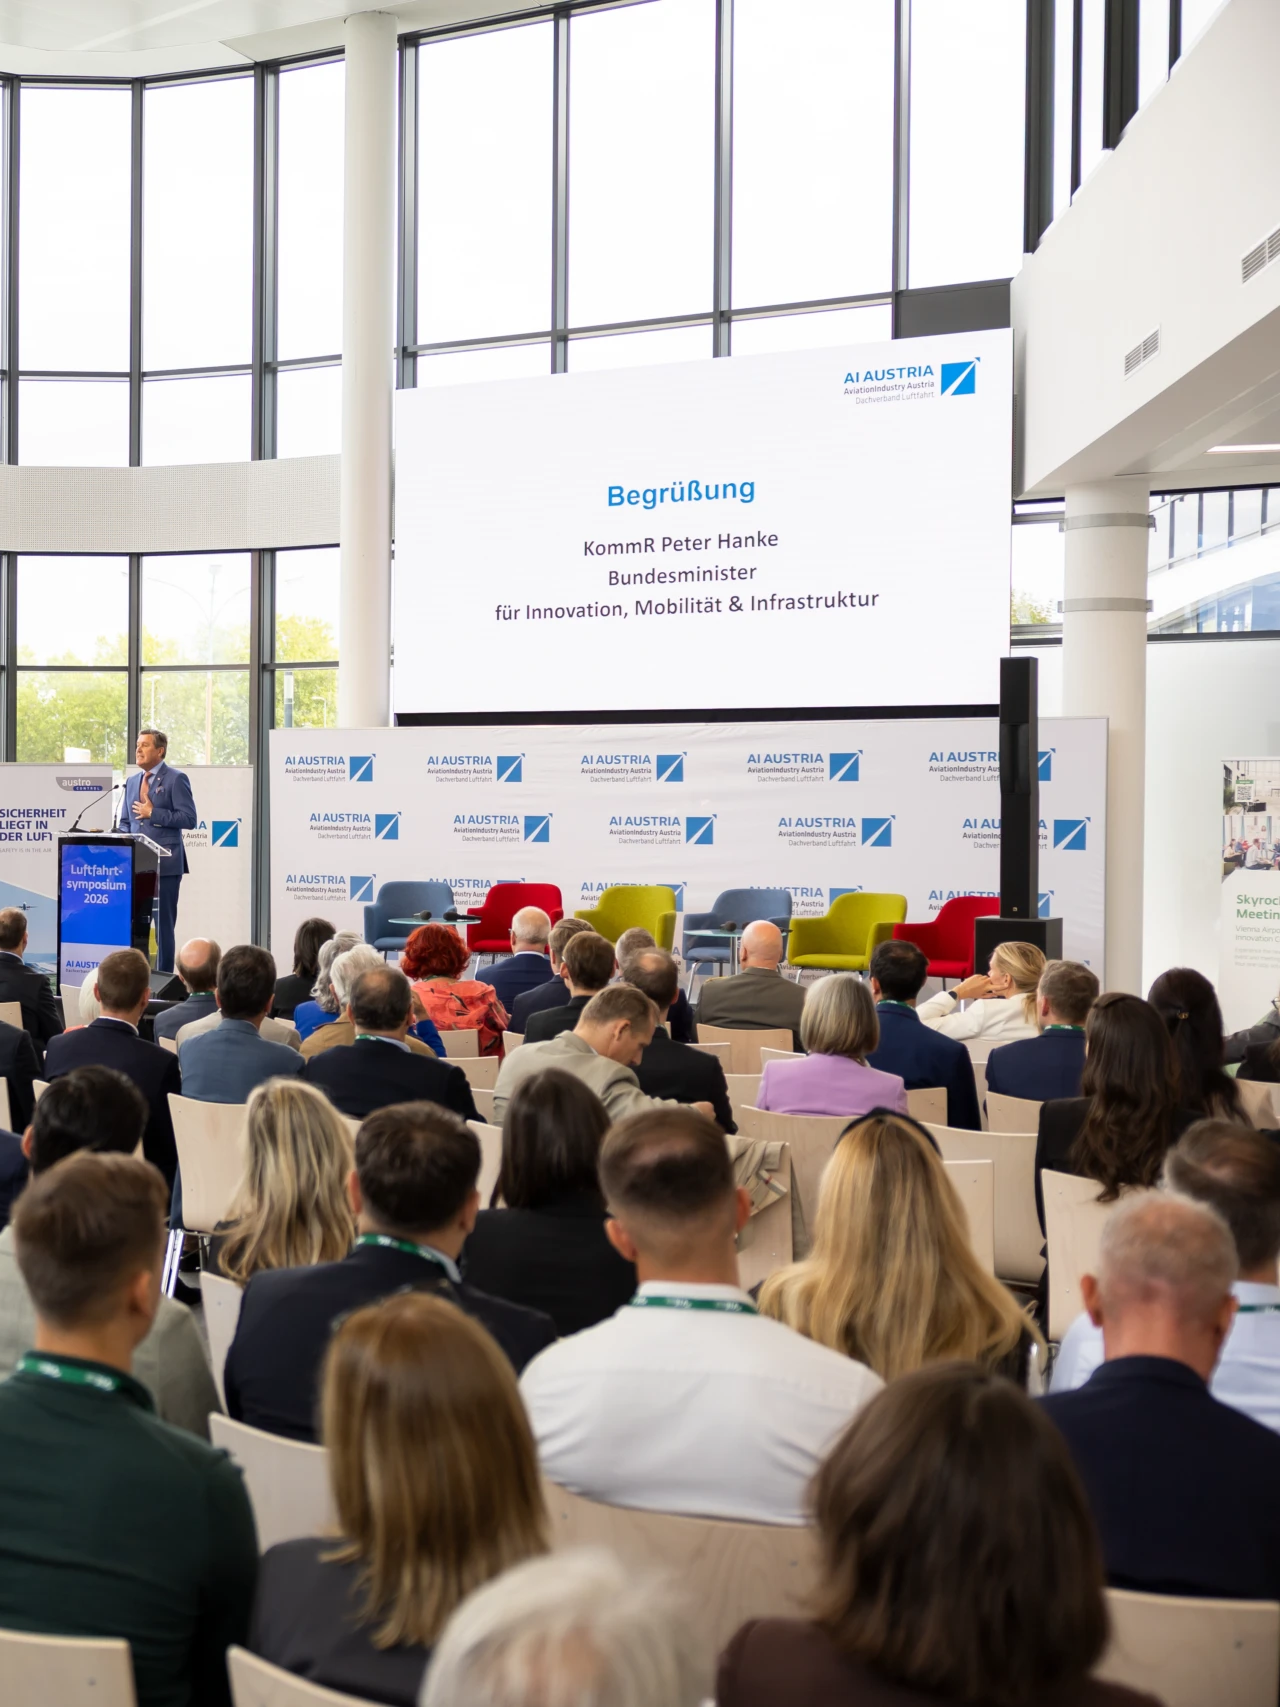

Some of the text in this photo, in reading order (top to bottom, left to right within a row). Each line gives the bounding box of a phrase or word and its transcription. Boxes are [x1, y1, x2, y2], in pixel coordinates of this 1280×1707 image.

[844, 365, 934, 384] AI AUSTRIA
[844, 380, 934, 395] AviationIndustry Austria
[856, 391, 934, 405] Dachverband Luftfahrt
[608, 479, 755, 510] Begrüßung
[584, 531, 779, 556] KommR Peter Hanke
[608, 565, 757, 586] Bundesminister
[495, 590, 879, 621] für Innovation, Mobilität & Infrastruktur
[285, 756, 345, 765] AI AUSTRIA
[427, 756, 492, 765] AI AUSTRIA
[581, 755, 651, 764] AI AUSTRIA
[747, 753, 824, 764] AI AUSTRIA
[929, 752, 1000, 762] AI AUSTR
[581, 767, 629, 775] AviationIndustry
[747, 766, 800, 774] AviationIndustry
[929, 765, 986, 773] AviationIndustry
[62, 778, 91, 786] austro
[940, 774, 981, 782] Dachverband
[0, 808, 67, 818] SICHERHEIT
[310, 813, 370, 822] AI AUSTRIA
[0, 820, 48, 830] LIEGT IN
[453, 815, 519, 825] AI AUSTRIA
[609, 816, 681, 826] AI AUSTRIA
[778, 818, 856, 828] AI AUSTRIA
[963, 818, 978, 829] AI
[310, 824, 352, 832] AviationIndustry
[453, 827, 498, 835] AviationIndustry
[609, 828, 658, 836] AviationIndustry
[0, 832, 23, 841] DER
[496, 835, 520, 843] Luftfahrt
[778, 830, 832, 839] AviationIndustry
[655, 837, 681, 845] Luftfahrt
[828, 839, 856, 847] Luftfahrt
[71, 864, 123, 876] Luftfahrt-
[286, 874, 346, 884] AI AUSTRIA
[67, 879, 127, 892] symposium
[286, 886, 327, 894] AviationIndustry
[581, 882, 593, 892] AI
[84, 894, 109, 904] 2026
[928, 890, 943, 900] AI
